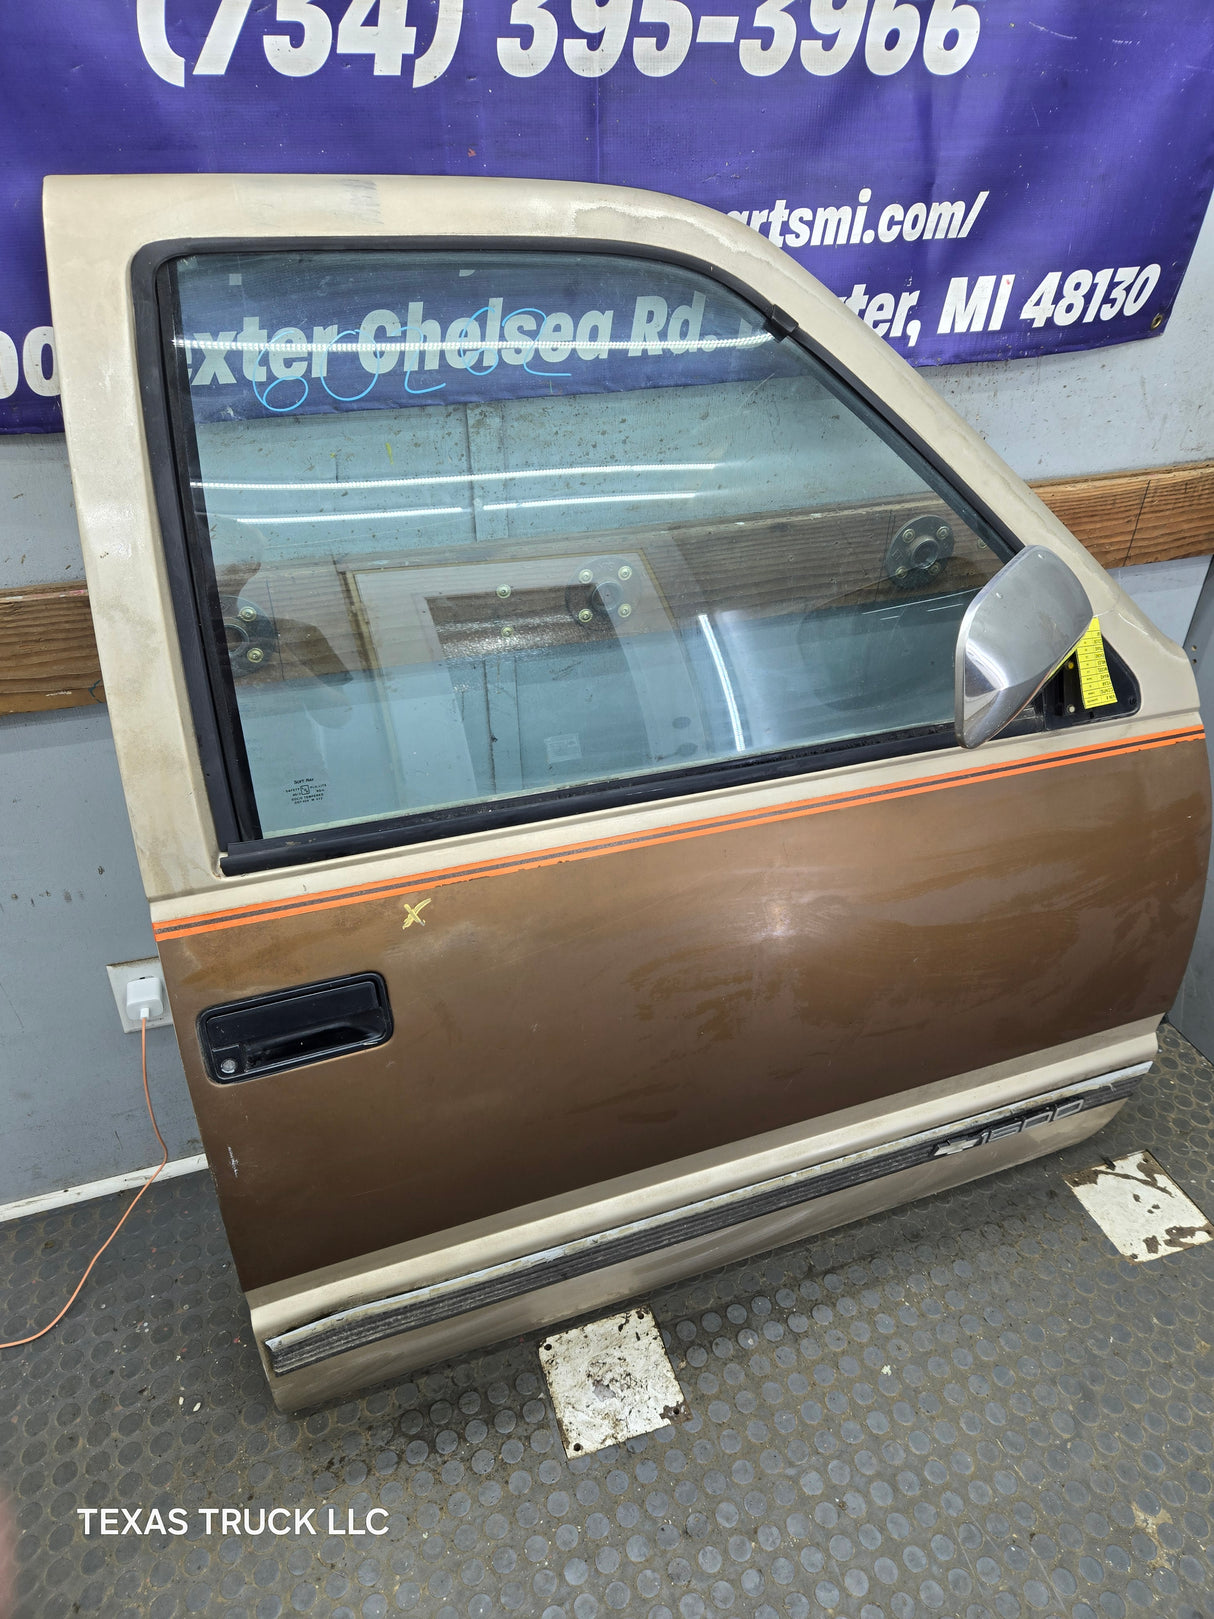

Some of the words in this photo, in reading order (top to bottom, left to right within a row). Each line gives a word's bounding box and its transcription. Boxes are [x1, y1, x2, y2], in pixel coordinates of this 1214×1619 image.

[136, 0, 463, 88] (734)
[496, 0, 981, 77] 395-3966
[359, 298, 613, 374] Chelsea
[627, 291, 717, 357] Rd.
[937, 274, 1015, 334] MI
[1020, 264, 1161, 328] 48130
